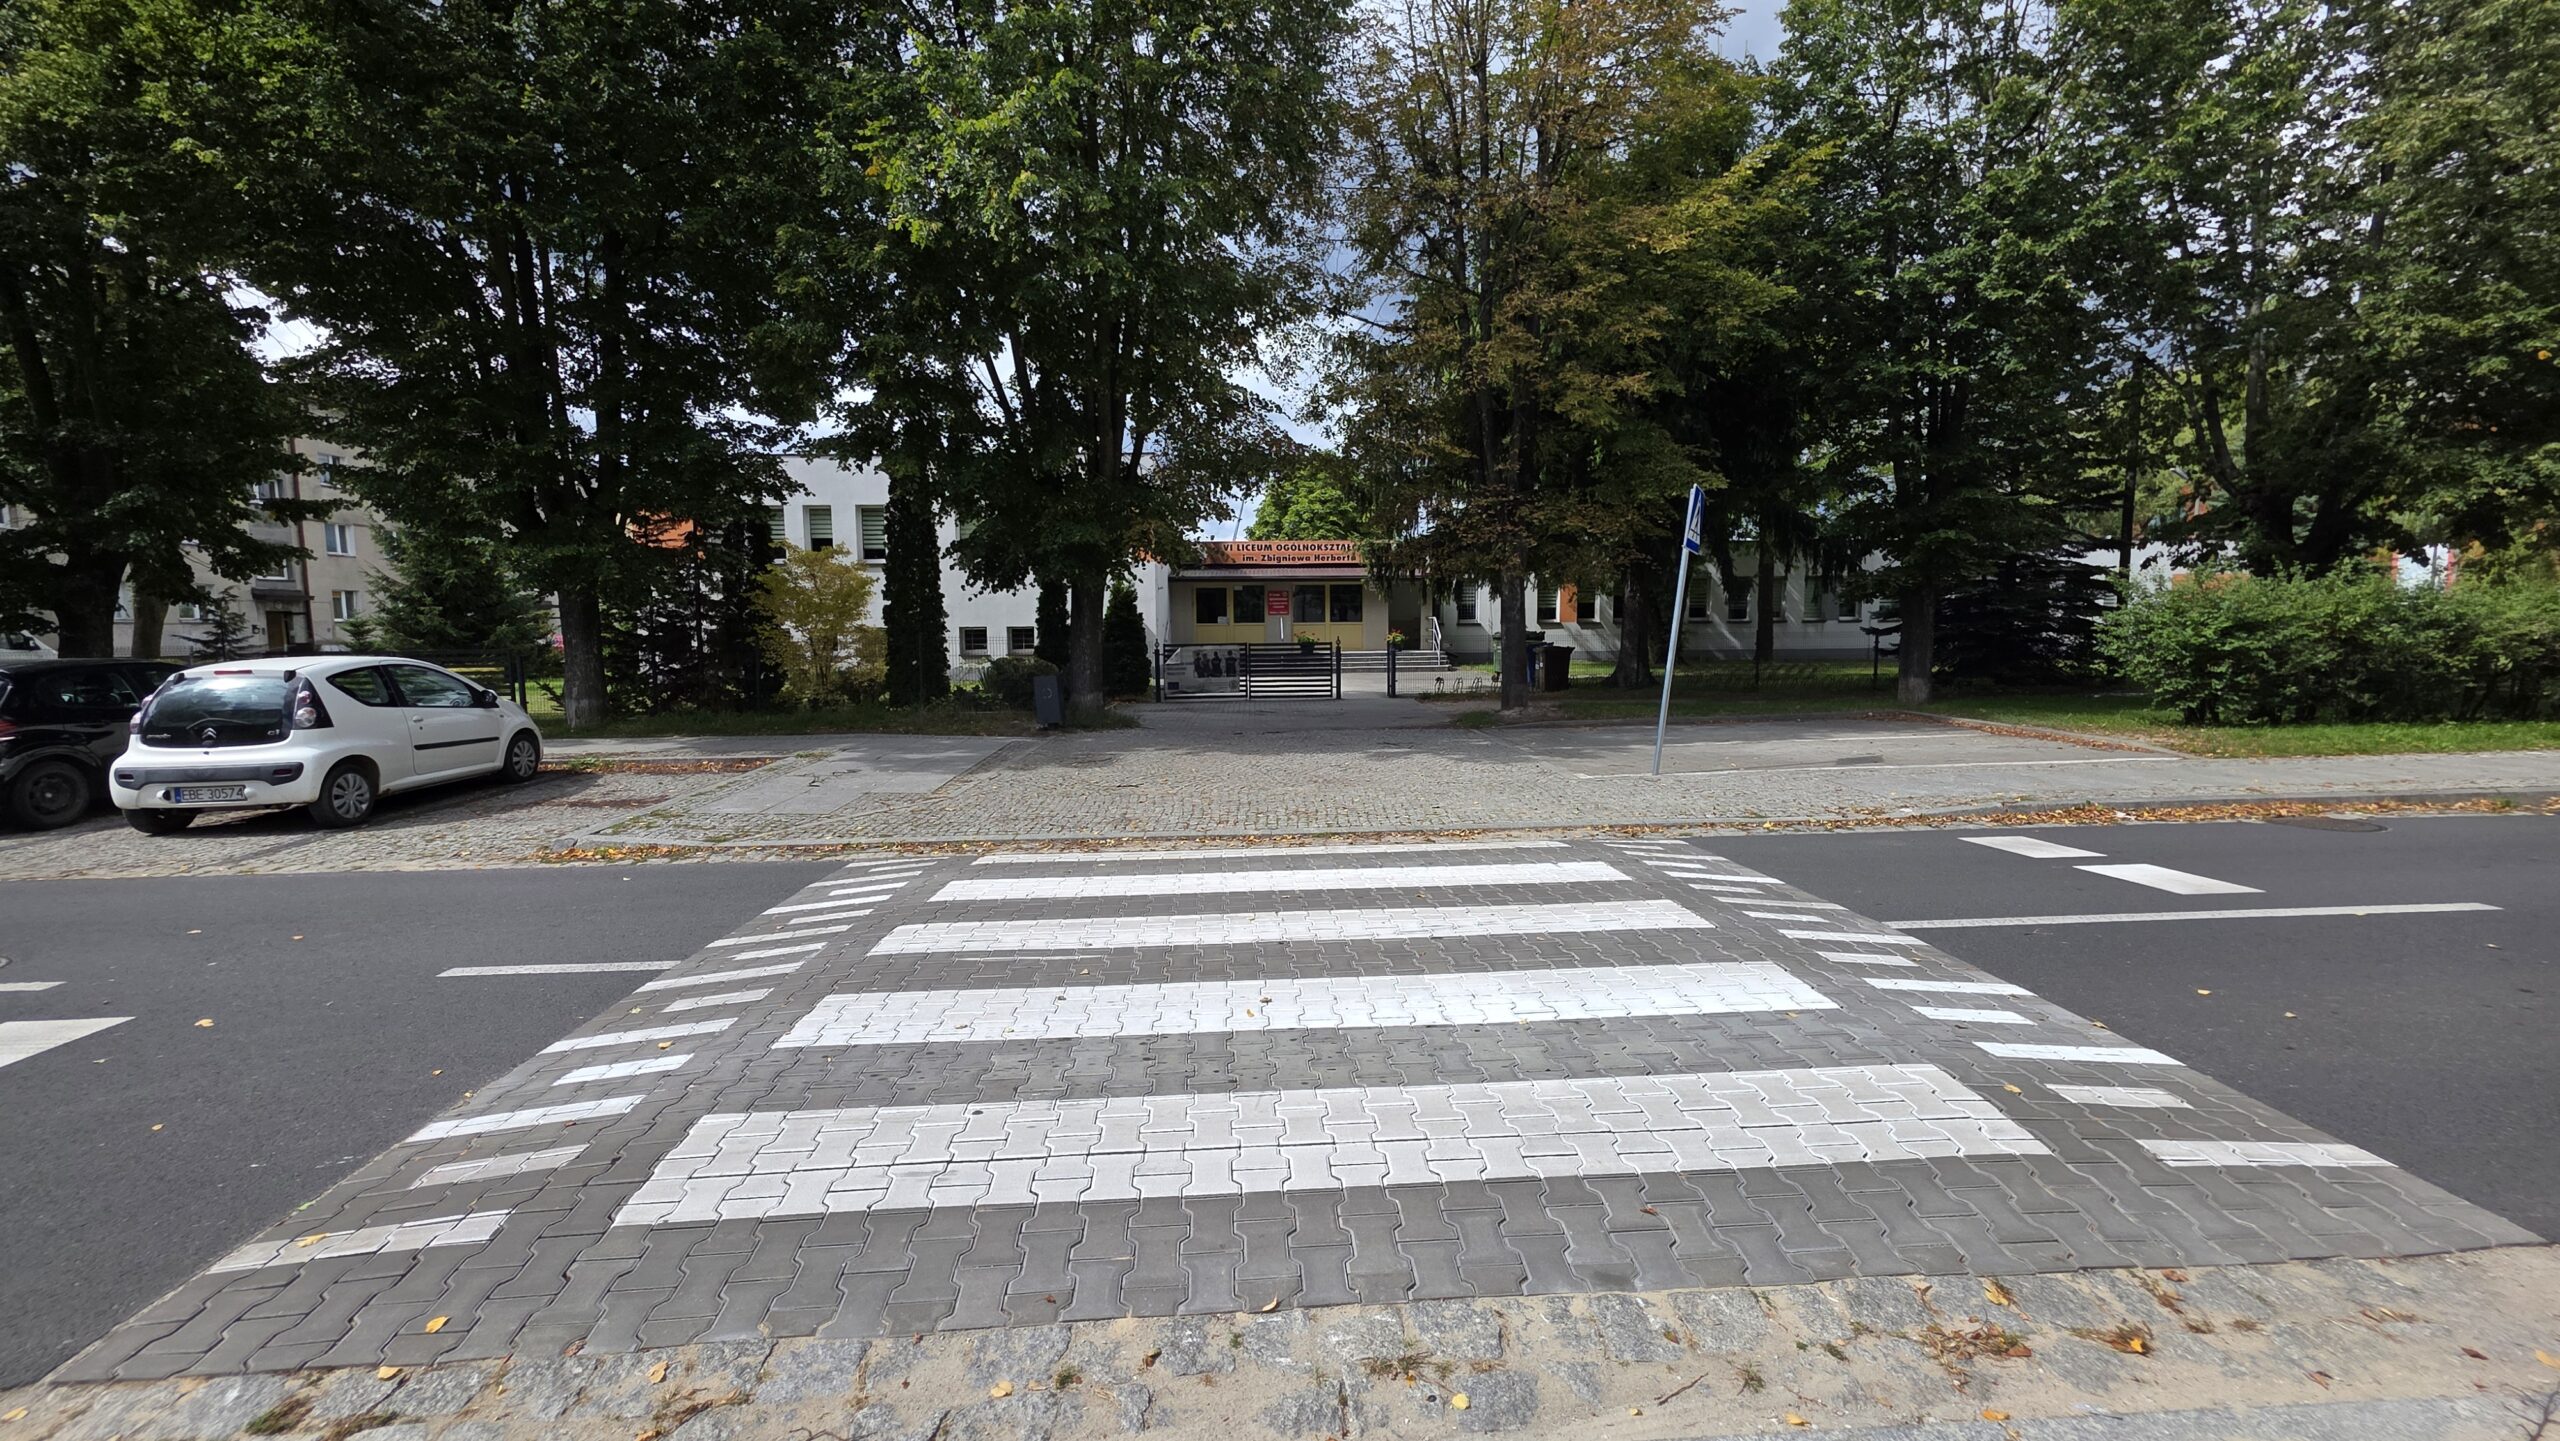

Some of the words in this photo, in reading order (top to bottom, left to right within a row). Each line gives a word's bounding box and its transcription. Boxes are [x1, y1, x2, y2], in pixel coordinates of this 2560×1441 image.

[1261, 554, 1311, 563] Zbigniewa
[182, 789, 204, 800] EBE
[207, 787, 244, 799] 30574
